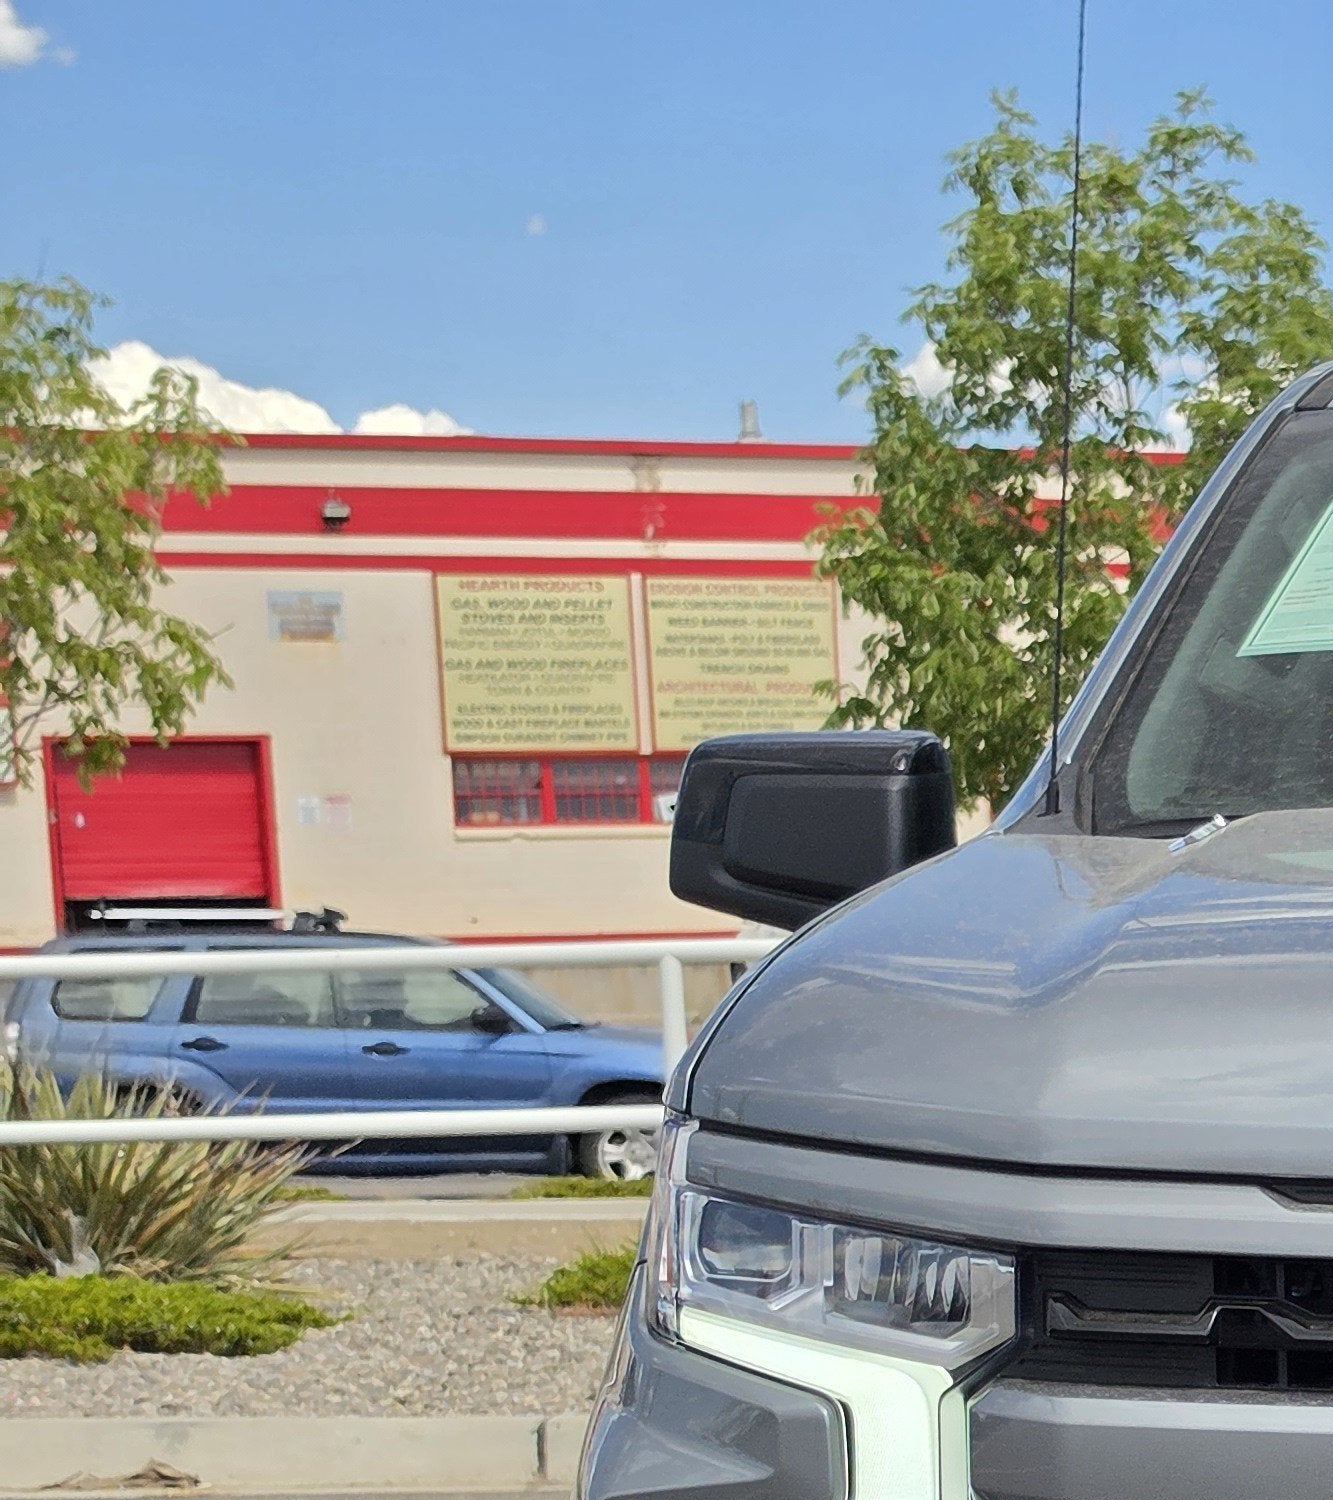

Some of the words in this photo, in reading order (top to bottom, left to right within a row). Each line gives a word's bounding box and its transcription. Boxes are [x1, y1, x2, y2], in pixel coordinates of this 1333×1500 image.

[459, 580, 520, 592] HEARTH
[523, 580, 605, 592] PRODUCTS
[487, 597, 530, 611] WOOD
[532, 597, 562, 611] AND
[564, 597, 613, 611] PELLET
[461, 613, 515, 625] STOVES
[518, 613, 547, 625] AND
[549, 613, 605, 625] INSERTS
[445, 657, 473, 671] GAS
[474, 657, 504, 671] AND
[506, 657, 548, 671] WOOD
[550, 657, 629, 671] FIREPLACES
